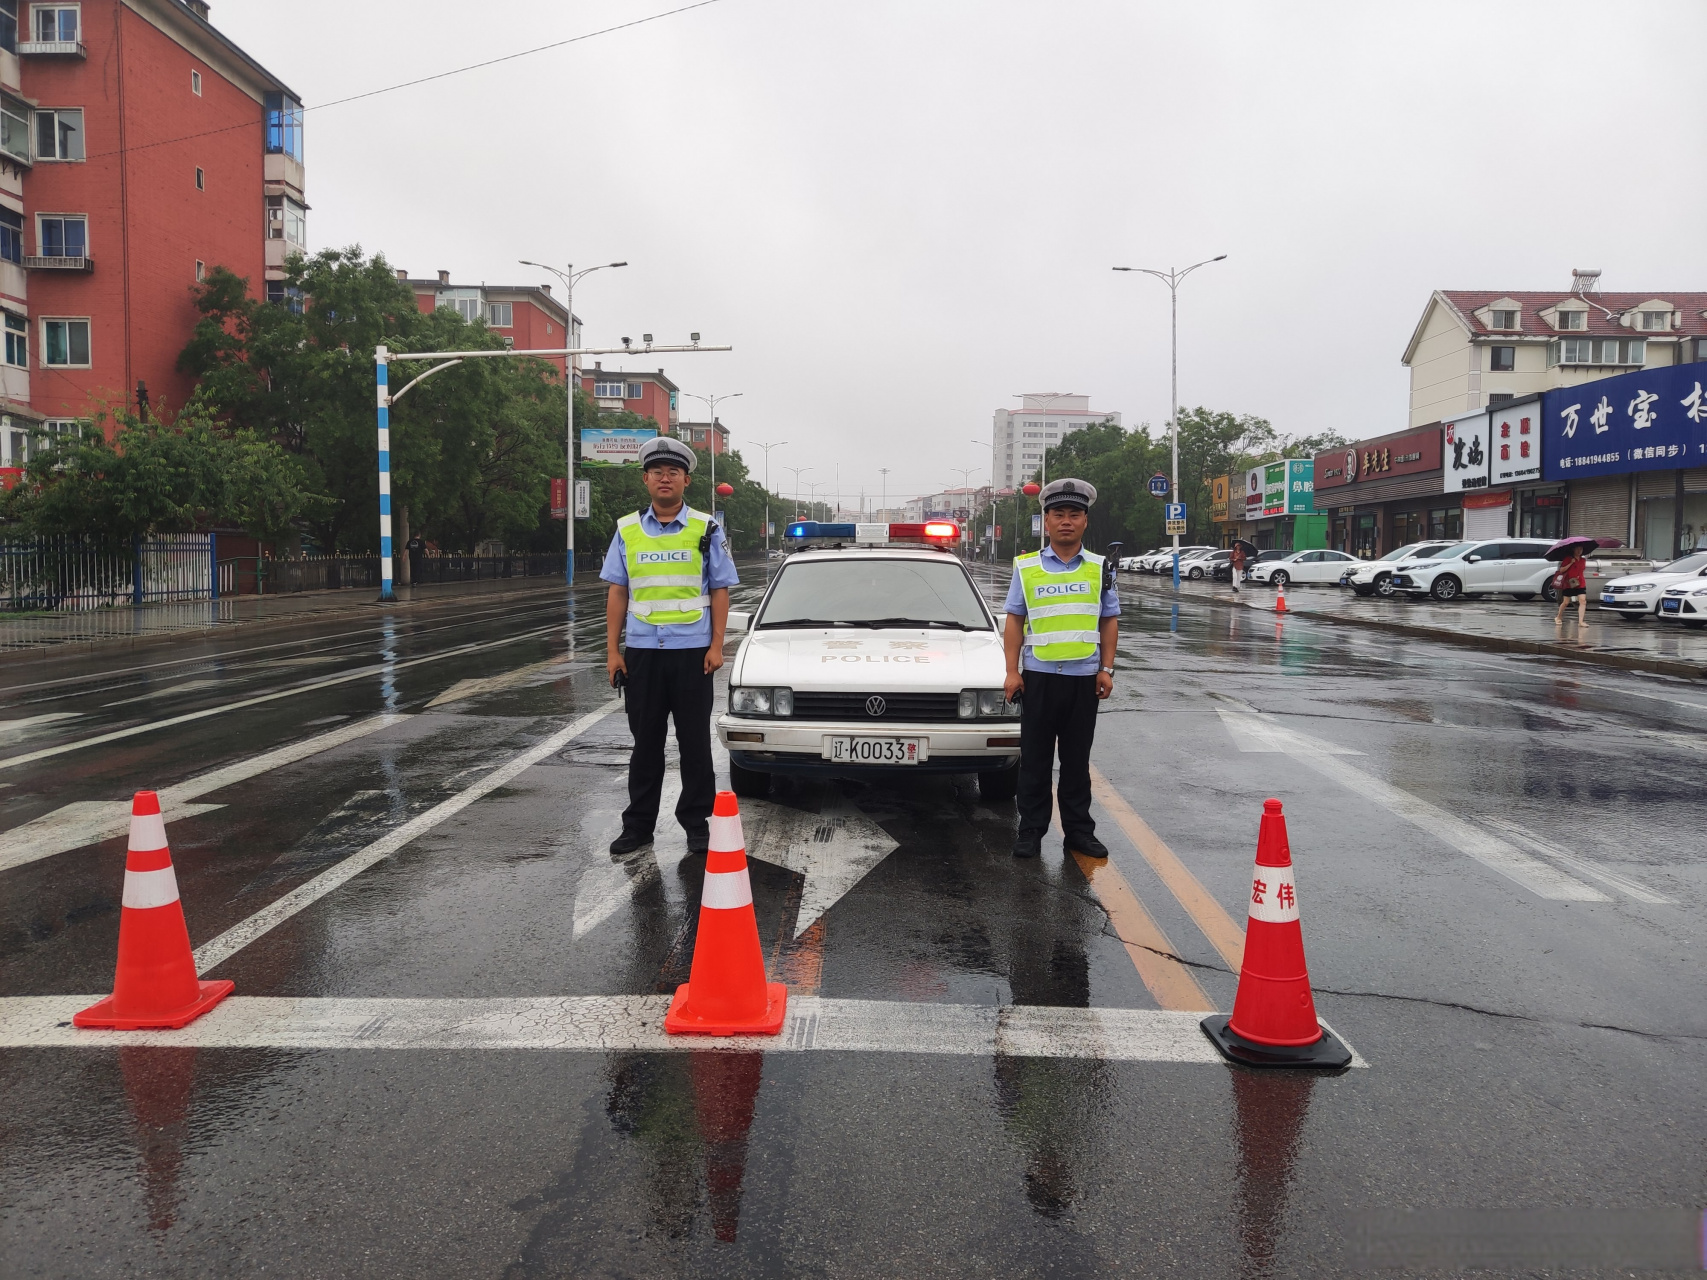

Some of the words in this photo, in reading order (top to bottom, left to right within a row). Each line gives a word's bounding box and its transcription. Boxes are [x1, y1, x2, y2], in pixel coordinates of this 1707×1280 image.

[1362, 447, 1390, 475] 李先生
[1169, 504, 1182, 519] P
[640, 551, 688, 562] POLICE
[1037, 583, 1086, 596] POLICE
[821, 655, 931, 664] POLICE
[1251, 878, 1295, 910] 宏伟
